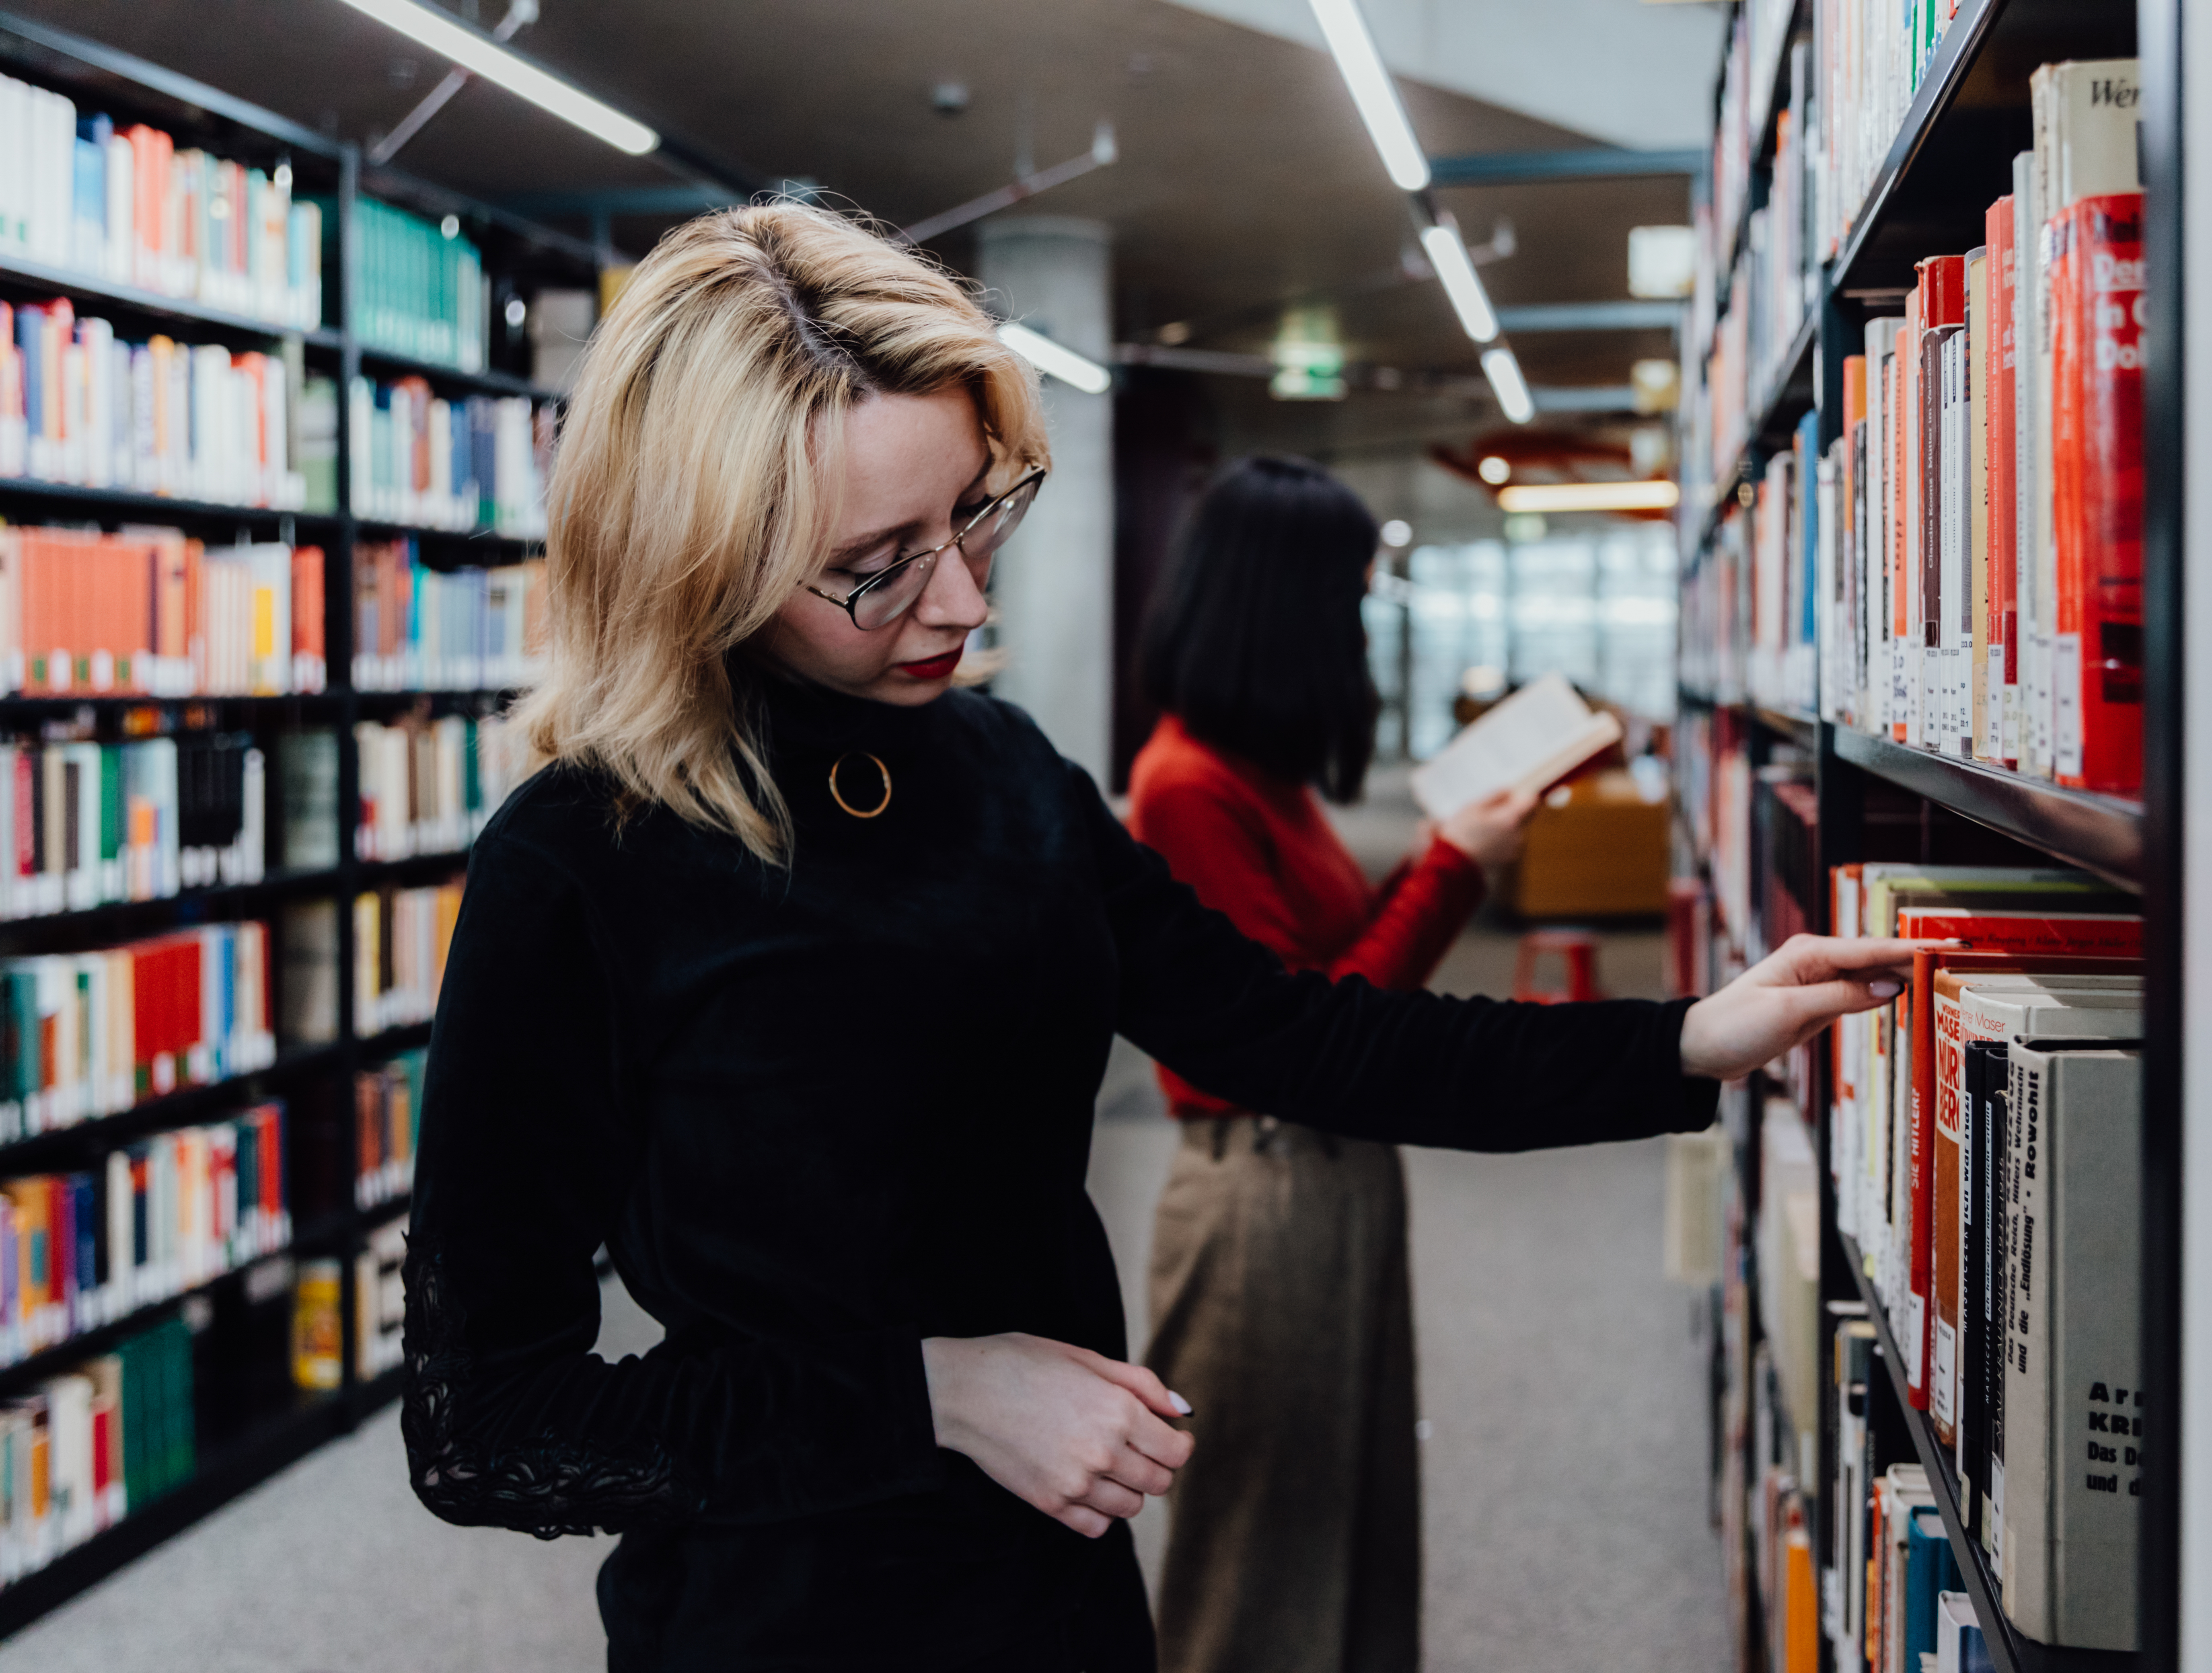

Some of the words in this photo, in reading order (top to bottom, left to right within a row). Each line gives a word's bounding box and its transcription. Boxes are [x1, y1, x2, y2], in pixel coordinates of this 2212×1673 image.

[1928, 408, 1932, 423] im
[1975, 1012, 2005, 1033] Maser
[1939, 1037, 1959, 1090] NÜR
[2014, 1065, 2024, 1148] Wehrmacht
[1911, 1087, 1920, 1156] HITLER?
[2025, 1070, 2038, 1180] Rowohlt
[1911, 1163, 1919, 1189] SIE
[2019, 1310, 2029, 1334] die
[2018, 1343, 2027, 1374] und
[2088, 1441, 2117, 1463] Das
[2087, 1474, 2117, 1492] und
